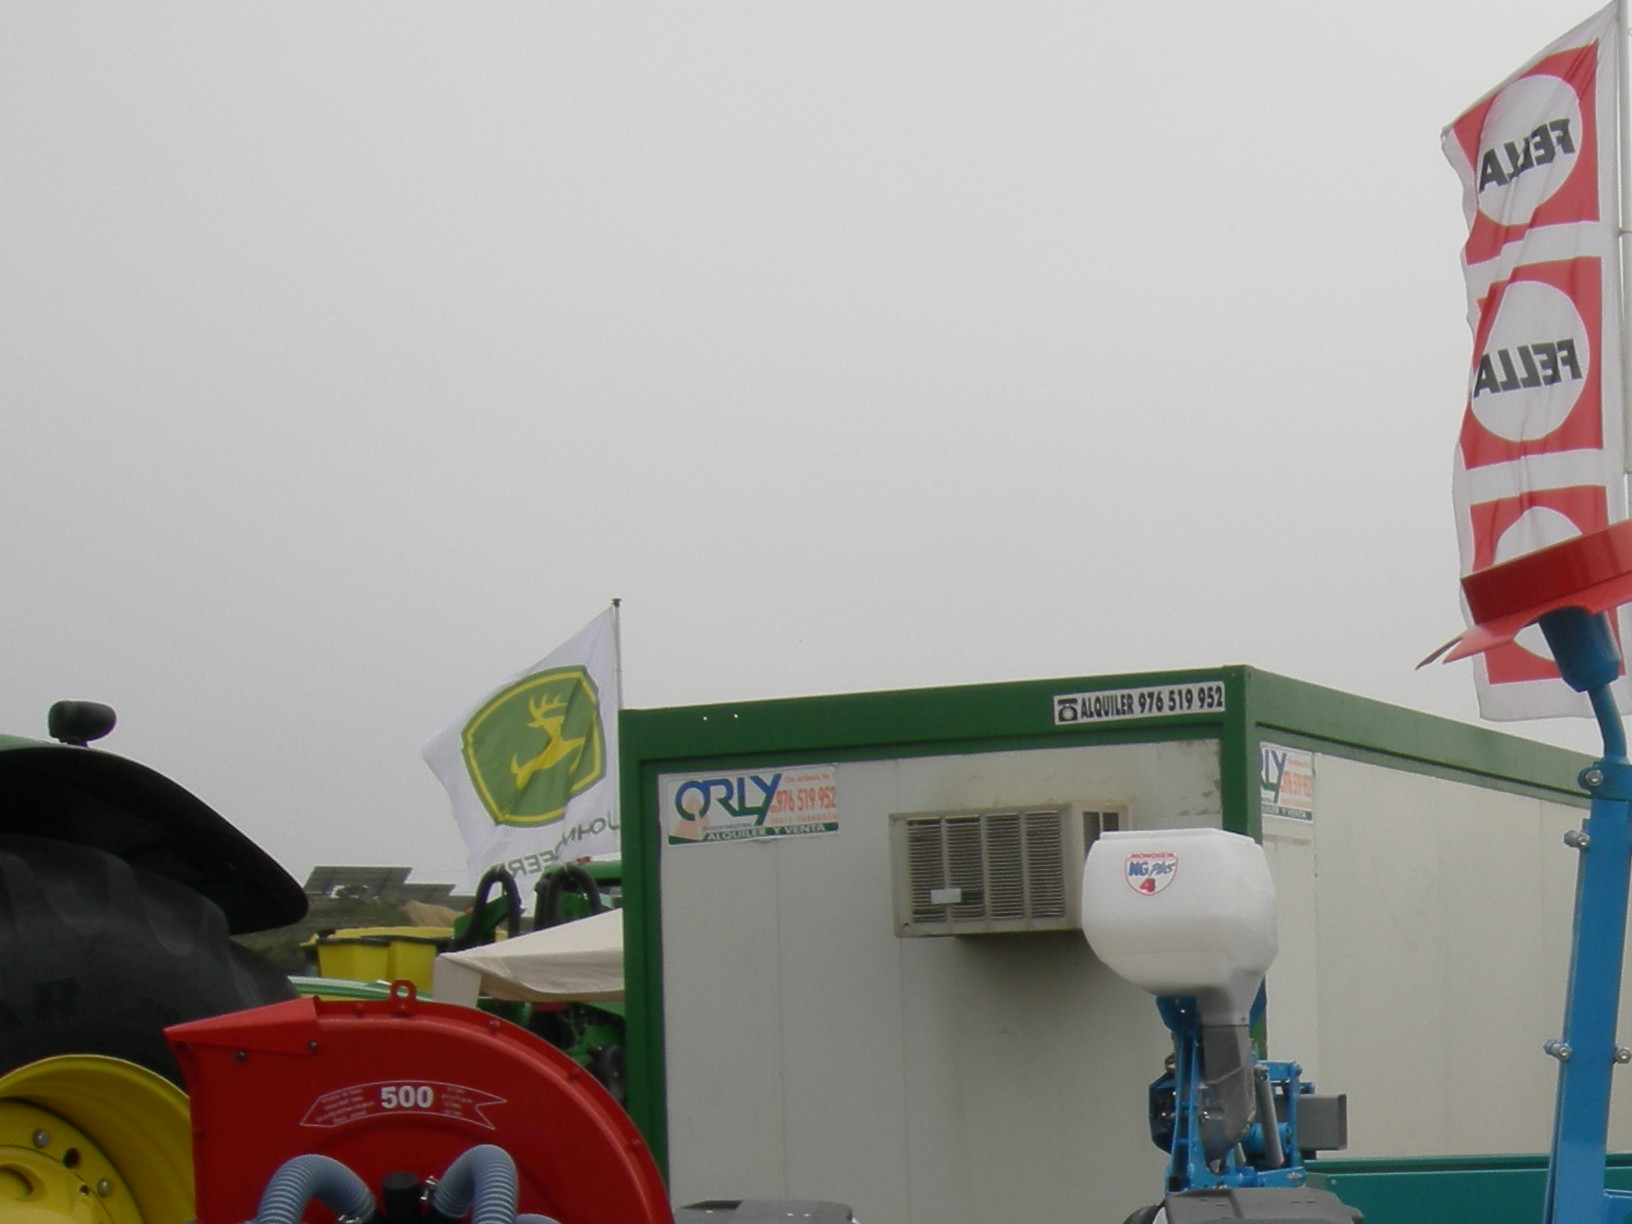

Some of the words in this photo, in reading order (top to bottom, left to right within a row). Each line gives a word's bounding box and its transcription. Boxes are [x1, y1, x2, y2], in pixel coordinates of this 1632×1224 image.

[1080, 693, 1134, 719] ALQUILER
[1138, 692, 1164, 714] 976
[1168, 688, 1194, 712] 519
[1197, 685, 1224, 709] 952
[675, 773, 783, 826] ORLY
[707, 828, 766, 841] ALQUILER
[783, 823, 827, 834] VENTA
[1128, 861, 1150, 876] NG
[1138, 877, 1156, 893] 4
[380, 1085, 434, 1109] 500
